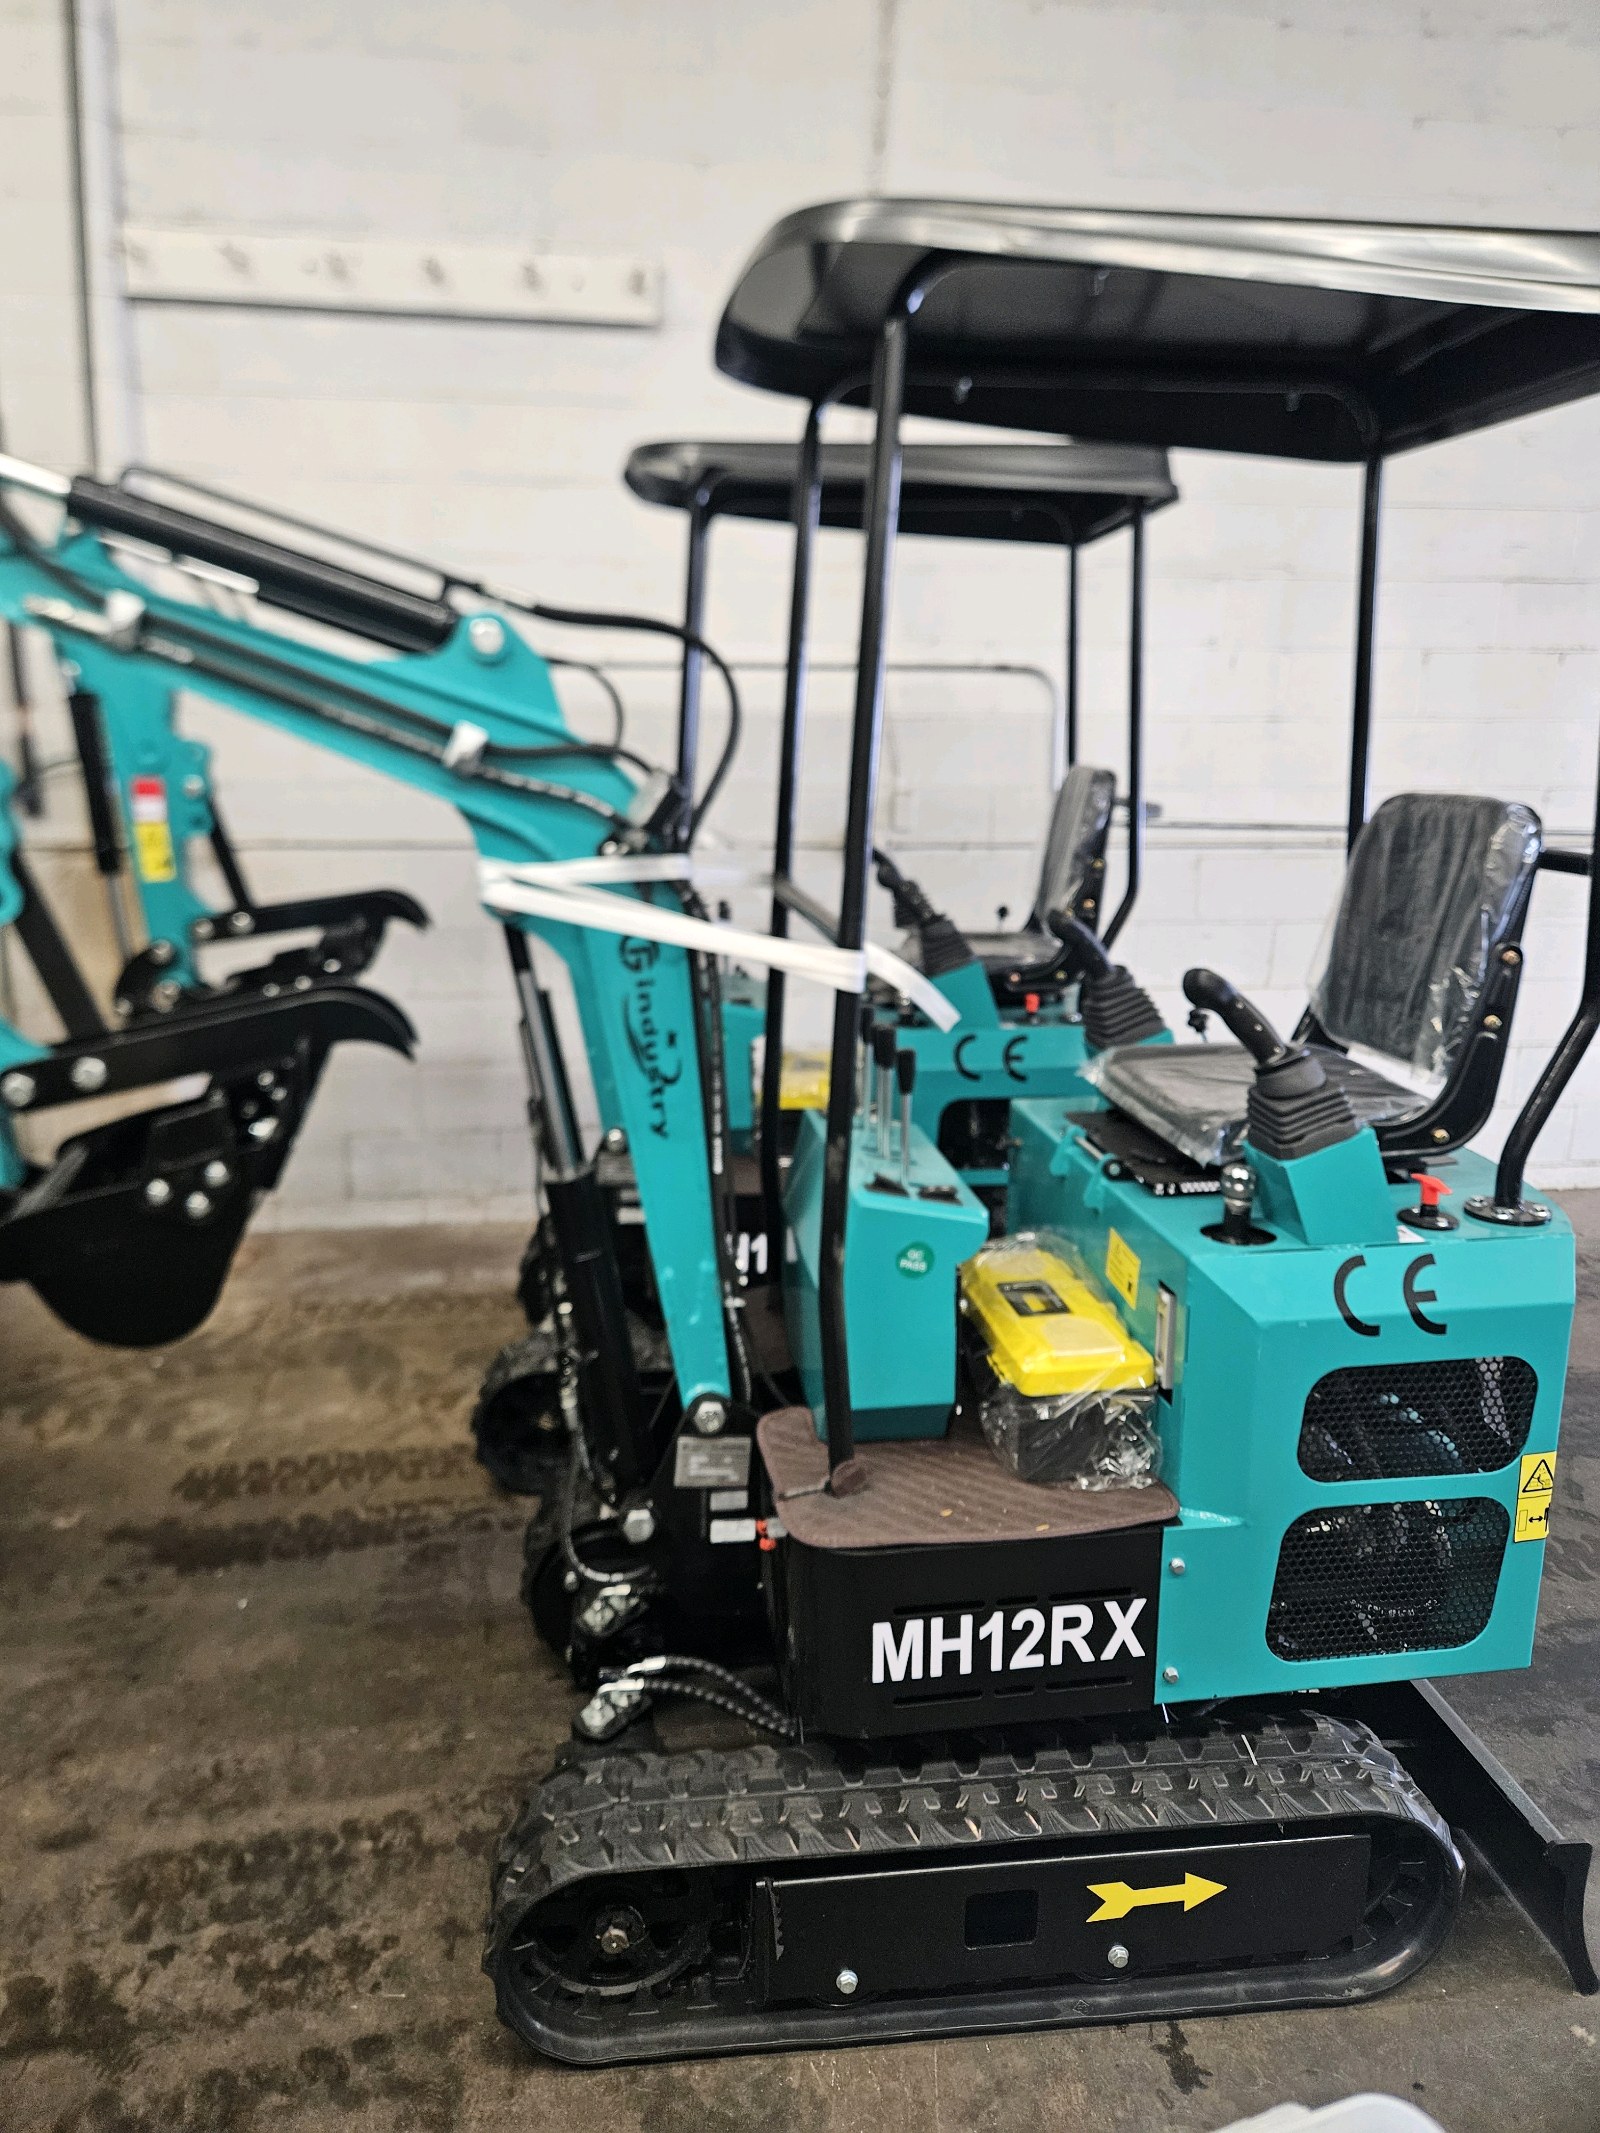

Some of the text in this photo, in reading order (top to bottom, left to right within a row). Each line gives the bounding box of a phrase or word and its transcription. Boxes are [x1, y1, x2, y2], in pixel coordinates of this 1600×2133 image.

[953, 1034, 1029, 1082] CE
[1334, 1253, 1448, 1337] CE
[872, 1598, 1148, 1684] MH12RX
